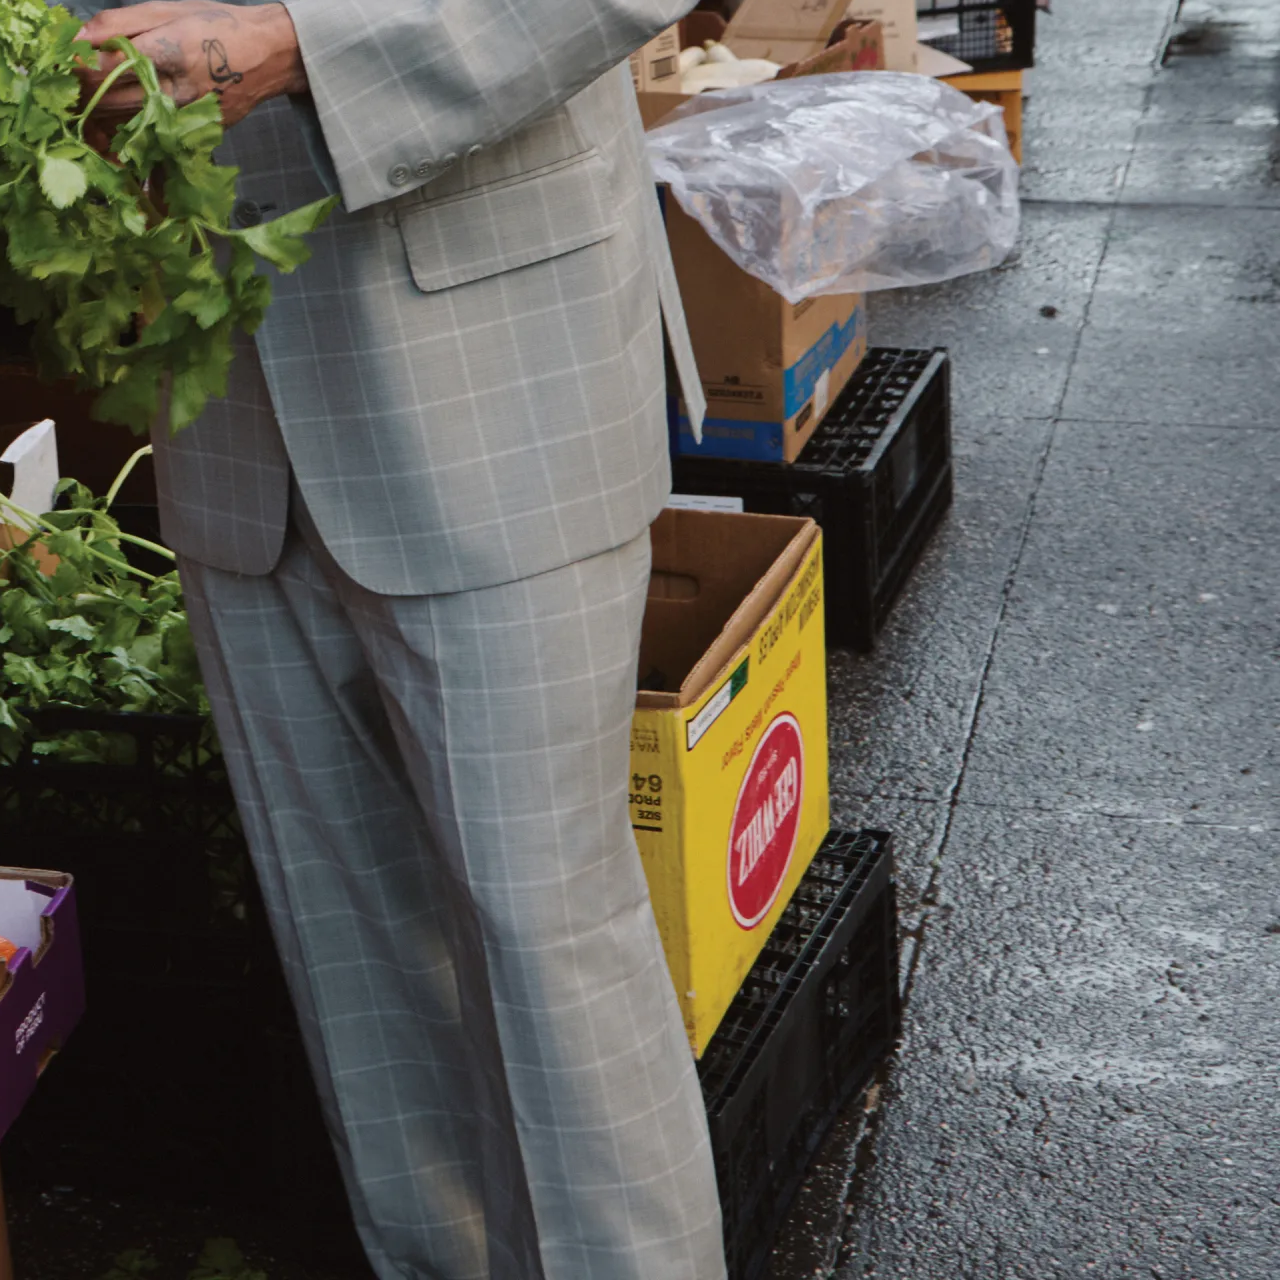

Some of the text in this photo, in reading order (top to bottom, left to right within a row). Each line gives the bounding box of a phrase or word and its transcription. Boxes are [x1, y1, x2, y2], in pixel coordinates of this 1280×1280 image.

[632, 773, 662, 793] 64
[774, 756, 798, 828] GEE
[637, 809, 662, 821] SIZE
[734, 794, 776, 886] WHIZ
